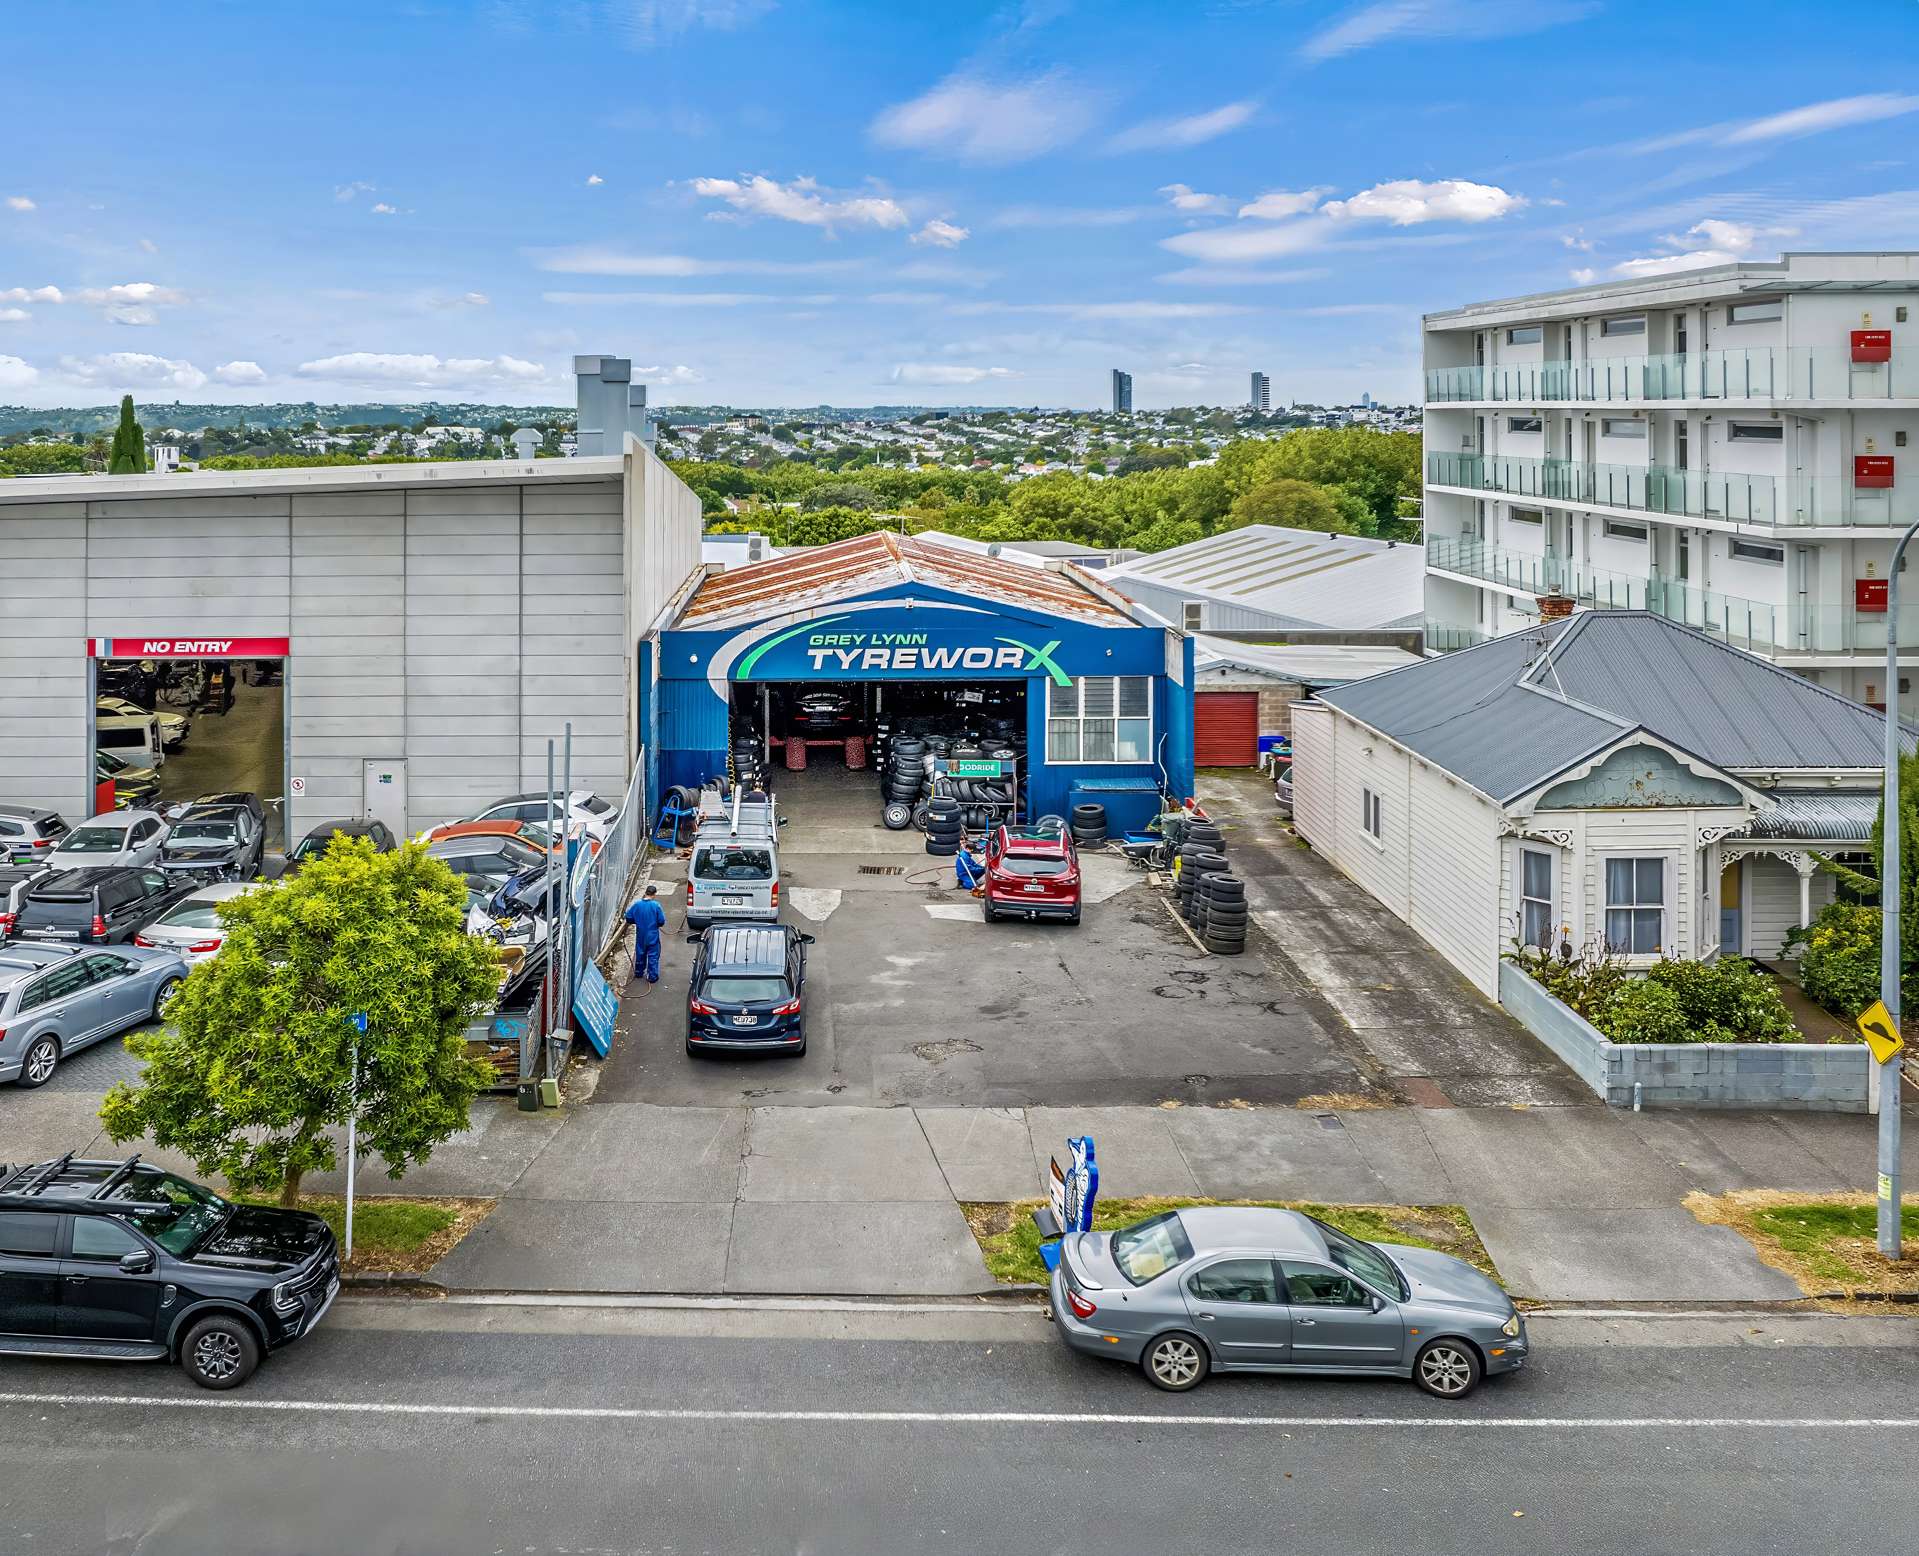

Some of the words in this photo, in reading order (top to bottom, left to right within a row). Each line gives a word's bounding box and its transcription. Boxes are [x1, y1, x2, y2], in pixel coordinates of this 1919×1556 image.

[809, 634, 867, 646] GREY
[871, 634, 927, 645] LYNN
[143, 641, 170, 653] NO
[173, 641, 232, 653] ENTRY
[807, 637, 1073, 686] TYREWORX
